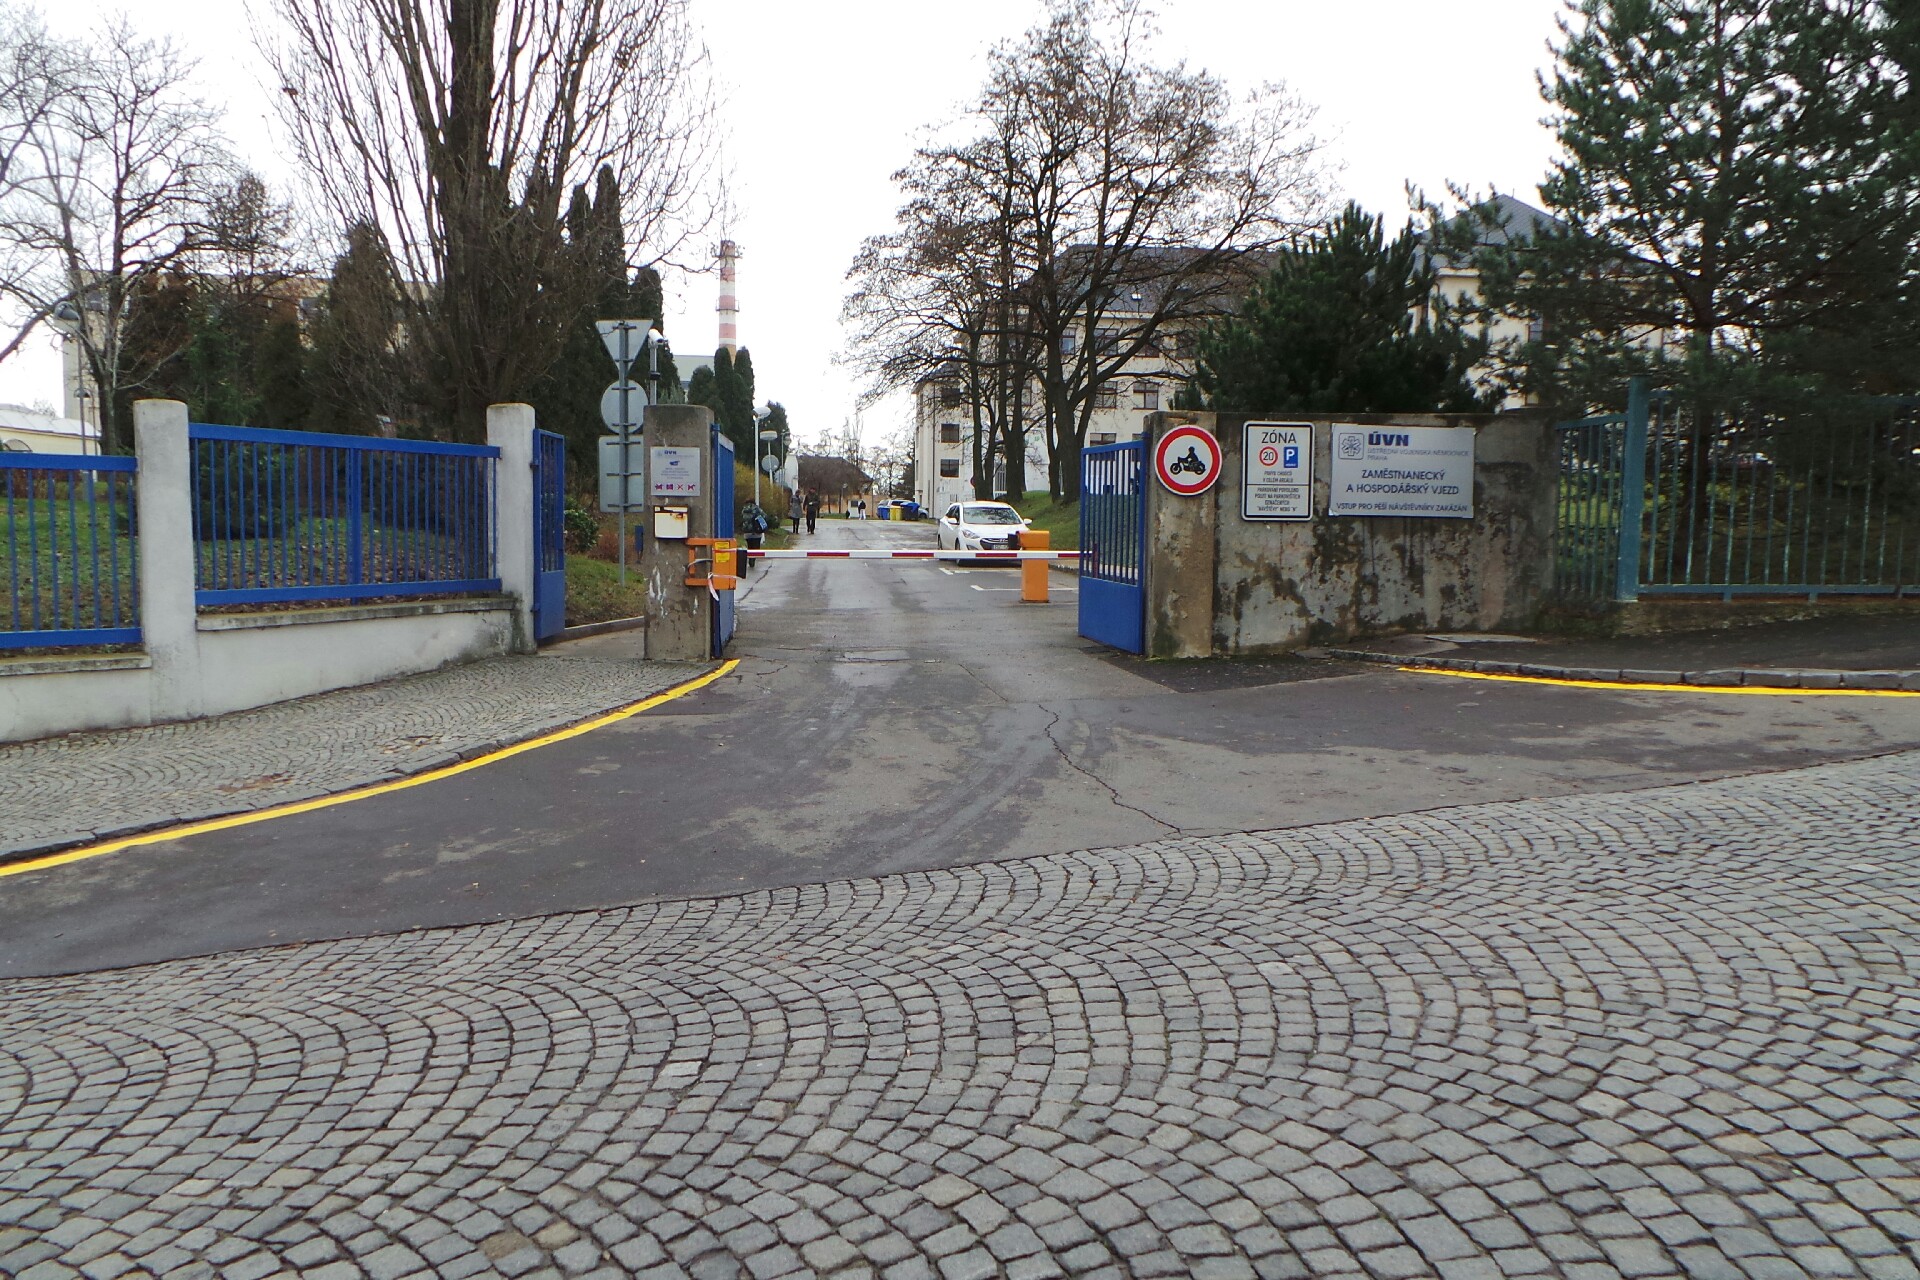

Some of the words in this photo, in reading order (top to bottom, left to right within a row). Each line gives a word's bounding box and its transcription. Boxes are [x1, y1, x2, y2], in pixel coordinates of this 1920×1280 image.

[1261, 430, 1296, 444] ZÓNA
[1368, 431, 1409, 446] ÚVN
[1263, 452, 1274, 460] 20
[1286, 450, 1294, 460] P
[1362, 468, 1446, 480] ZAMĚSTNANECKÝ
[1346, 484, 1353, 493] A
[1356, 482, 1429, 494] HOSPODÁŘSKÝ
[1431, 485, 1459, 495] VJEZD
[1389, 503, 1434, 511] NÁVŠTĚVNÍKY
